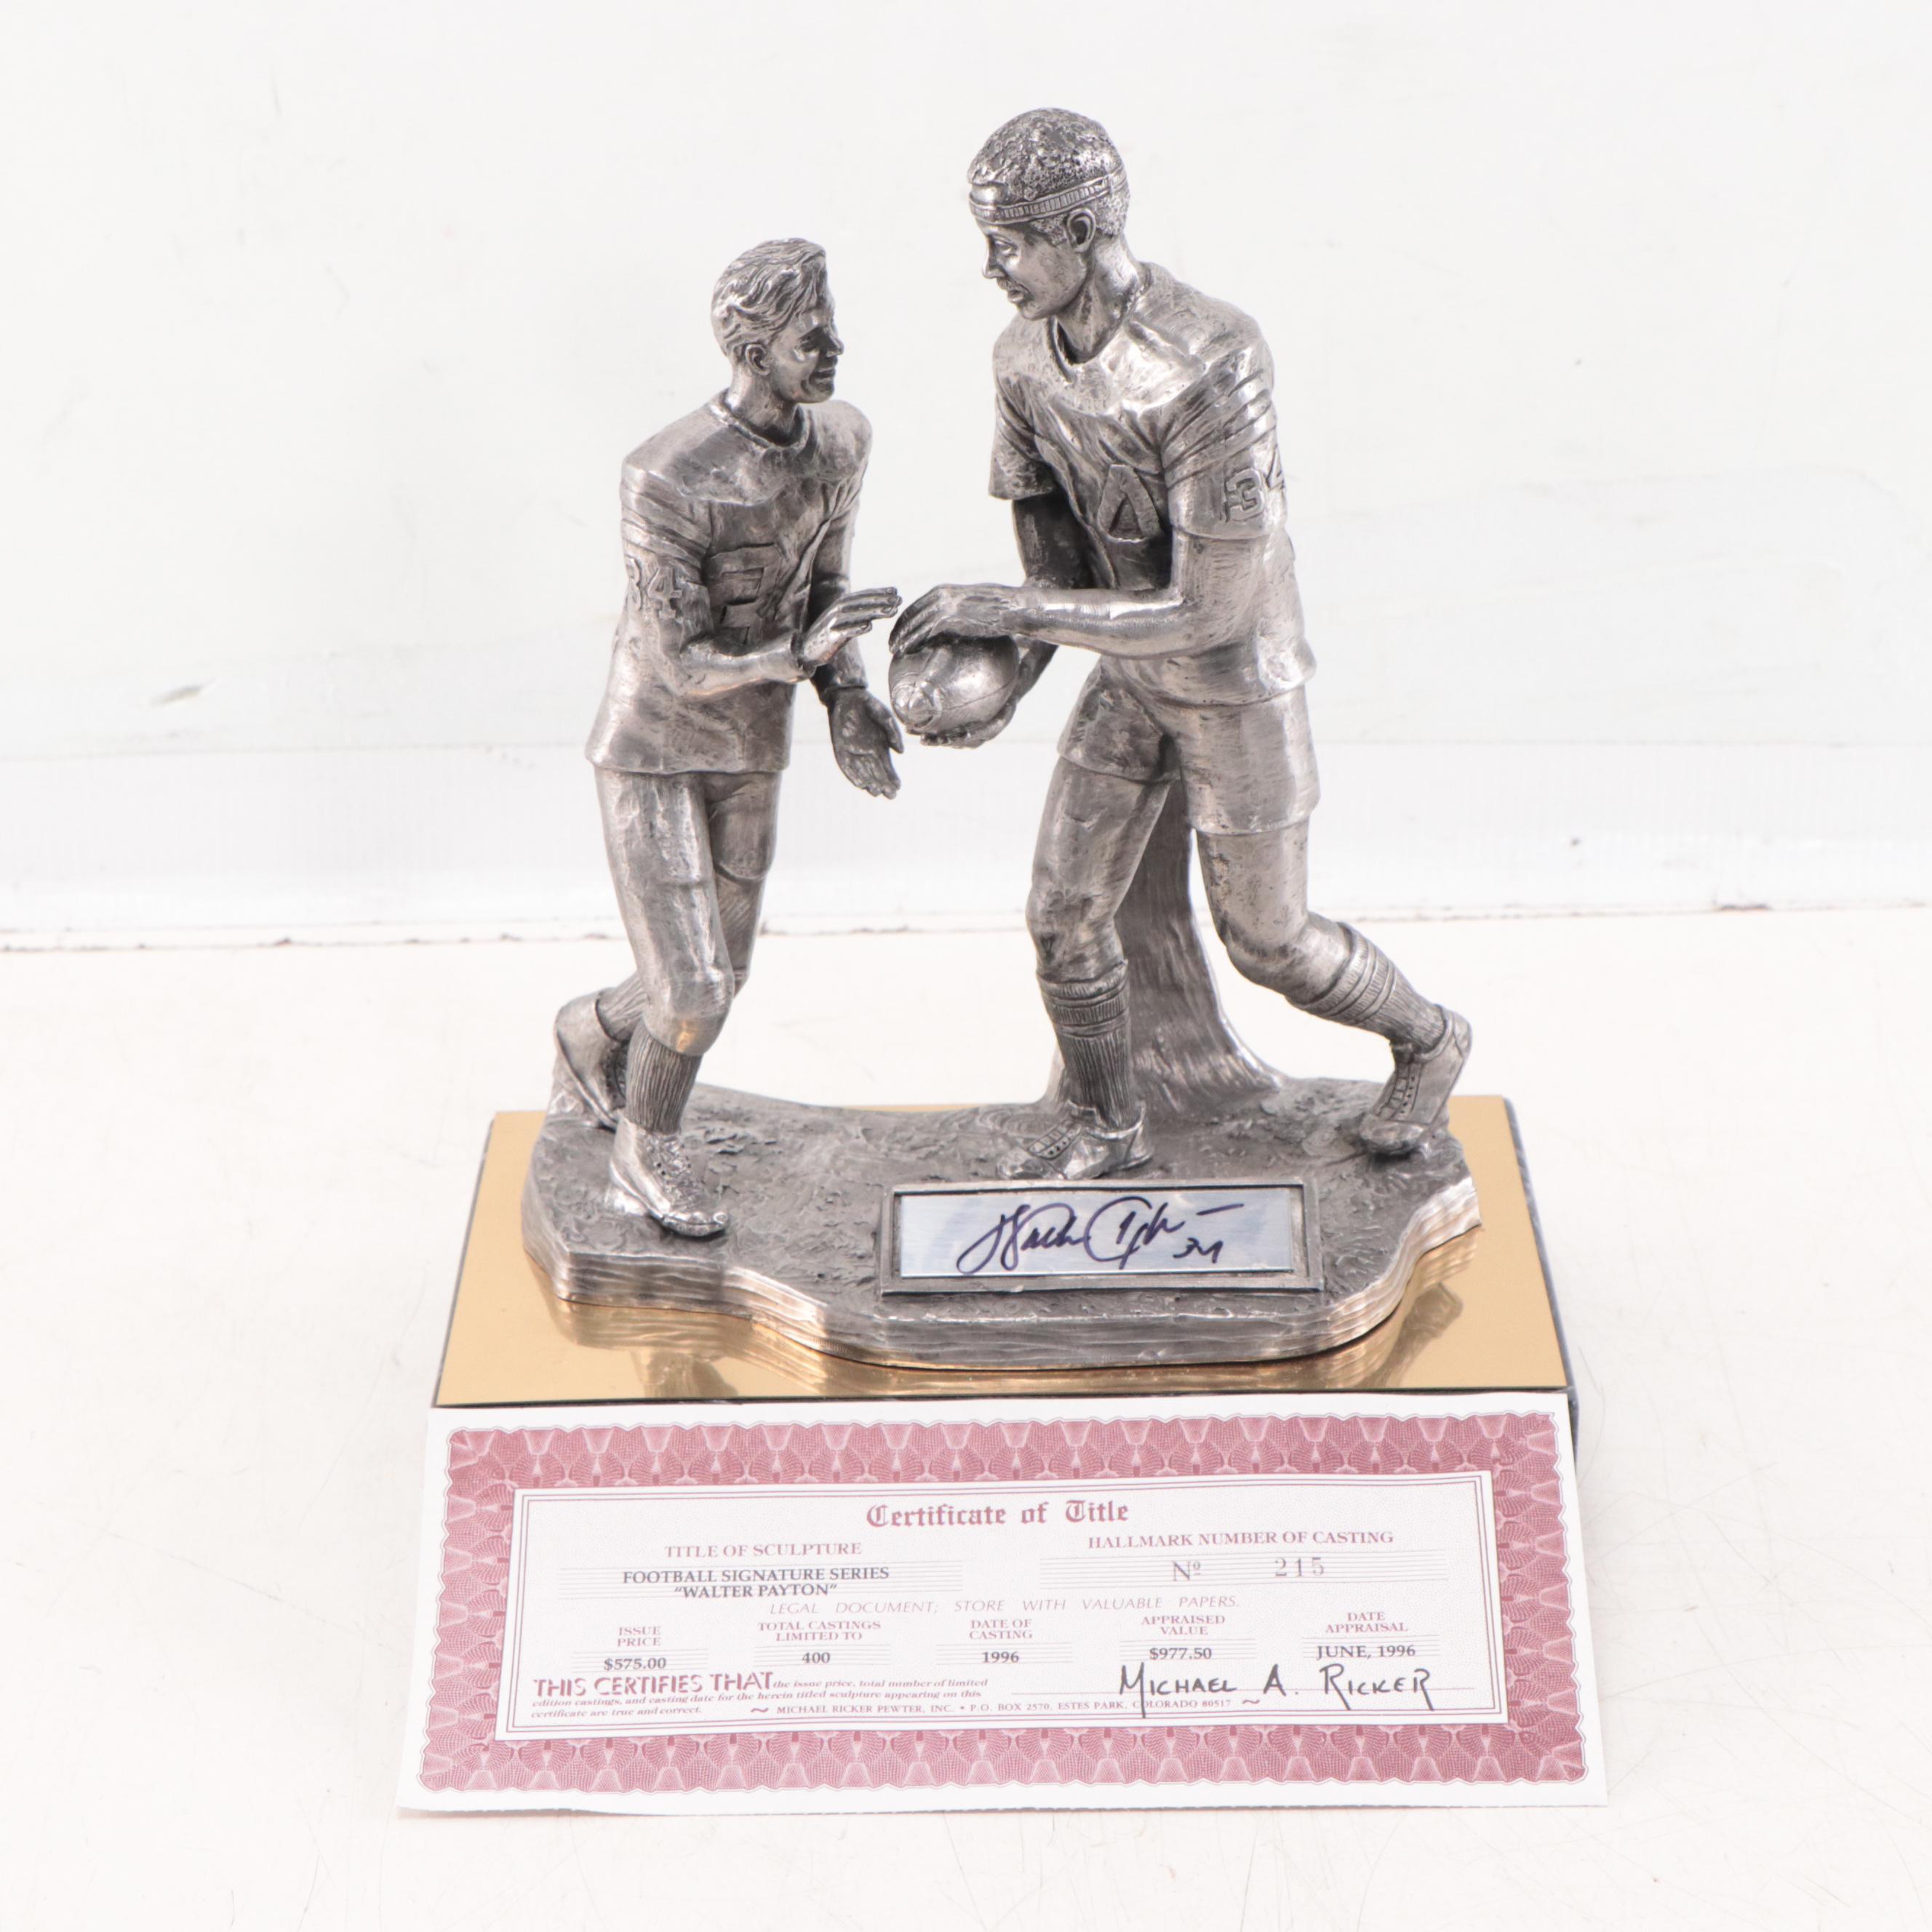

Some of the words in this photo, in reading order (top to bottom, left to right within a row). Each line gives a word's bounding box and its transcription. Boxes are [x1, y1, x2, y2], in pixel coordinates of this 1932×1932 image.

[867, 1501, 1007, 1528] Certificate
[1021, 1501, 1047, 1525] of
[1064, 1501, 1130, 1522] Title
[1087, 1534, 1192, 1549] HALLMARK
[1198, 1533, 1277, 1546] NUMBER
[1282, 1531, 1309, 1544] OF
[1312, 1530, 1394, 1544] CASTING
[664, 1545, 719, 1558] TITLE
[723, 1544, 749, 1557] OF
[752, 1542, 862, 1556] SCULPTURE
[1274, 1556, 1325, 1577] 215
[622, 1570, 717, 1584] FOOTBALL
[722, 1568, 825, 1582] SIGNATURE
[829, 1567, 889, 1581] SERIES
[770, 1602, 819, 1614] LEGAL
[834, 1600, 939, 1614] DOCUMENT;
[954, 1600, 1005, 1613] STORE
[1021, 1597, 1066, 1611] WITH
[1082, 1597, 1163, 1610] VALUABLE
[1178, 1595, 1241, 1609] PAPERS.
[970, 1619, 1008, 1629] DATE
[1012, 1618, 1032, 1629] OF
[1141, 1613, 1226, 1626] APPRAISED
[1346, 1611, 1386, 1622] DATE
[617, 1626, 662, 1637] ISSUE
[757, 1621, 804, 1632] TOTAL
[808, 1620, 881, 1632] CASTINGS
[1159, 1624, 1209, 1637] VALUE
[1325, 1621, 1408, 1633] APPRAISAL
[775, 1632, 839, 1642] LIMITED
[842, 1631, 863, 1641] TO
[969, 1629, 1033, 1640] CASTING
[616, 1637, 662, 1648] PRICE
[802, 1651, 831, 1664] 400
[981, 1650, 1020, 1664] 1996
[1149, 1646, 1213, 1661] $977.50
[1316, 1644, 1373, 1661] JUNE,
[1378, 1642, 1416, 1658] 1996
[604, 1656, 667, 1672] $575.00
[532, 1677, 587, 1698] THIS
[594, 1674, 703, 1696] CERTIFIES
[709, 1671, 773, 1692] THAT
[773, 1679, 791, 1688] the
[794, 1679, 822, 1688] issue
[859, 1678, 885, 1687] total
[888, 1678, 930, 1687] number
[948, 1678, 988, 1687] limited
[1320, 1663, 1435, 1712] RICKER
[532, 1698, 572, 1707] edition
[575, 1697, 623, 1707] castings,
[625, 1696, 647, 1704] and
[649, 1694, 688, 1705] casting
[690, 1693, 715, 1702] date
[717, 1693, 735, 1702] for
[736, 1692, 757, 1701] the
[757, 1691, 793, 1700] herein
[797, 1691, 826, 1699] titled
[829, 1690, 882, 1700] sculpture
[885, 1690, 941, 1700] appearing
[943, 1691, 957, 1699] on
[960, 1690, 982, 1698] this
[531, 1709, 587, 1718] certificate
[612, 1708, 635, 1716] true
[638, 1707, 660, 1715] and
[660, 1707, 702, 1715] correct.
[777, 1706, 828, 1715] MICHAEL
[832, 1705, 873, 1713] RICKER
[877, 1705, 926, 1715] PEWTER,
[930, 1704, 955, 1713] INC.
[970, 1703, 991, 1712] P.O.
[998, 1703, 1021, 1711] BOX
[1026, 1702, 1053, 1711] 2570,
[1058, 1702, 1090, 1710] ESTES
[1094, 1701, 1127, 1711] PARK,
[1133, 1699, 1198, 1708] COLORADO
[1202, 1699, 1231, 1707] 80517
